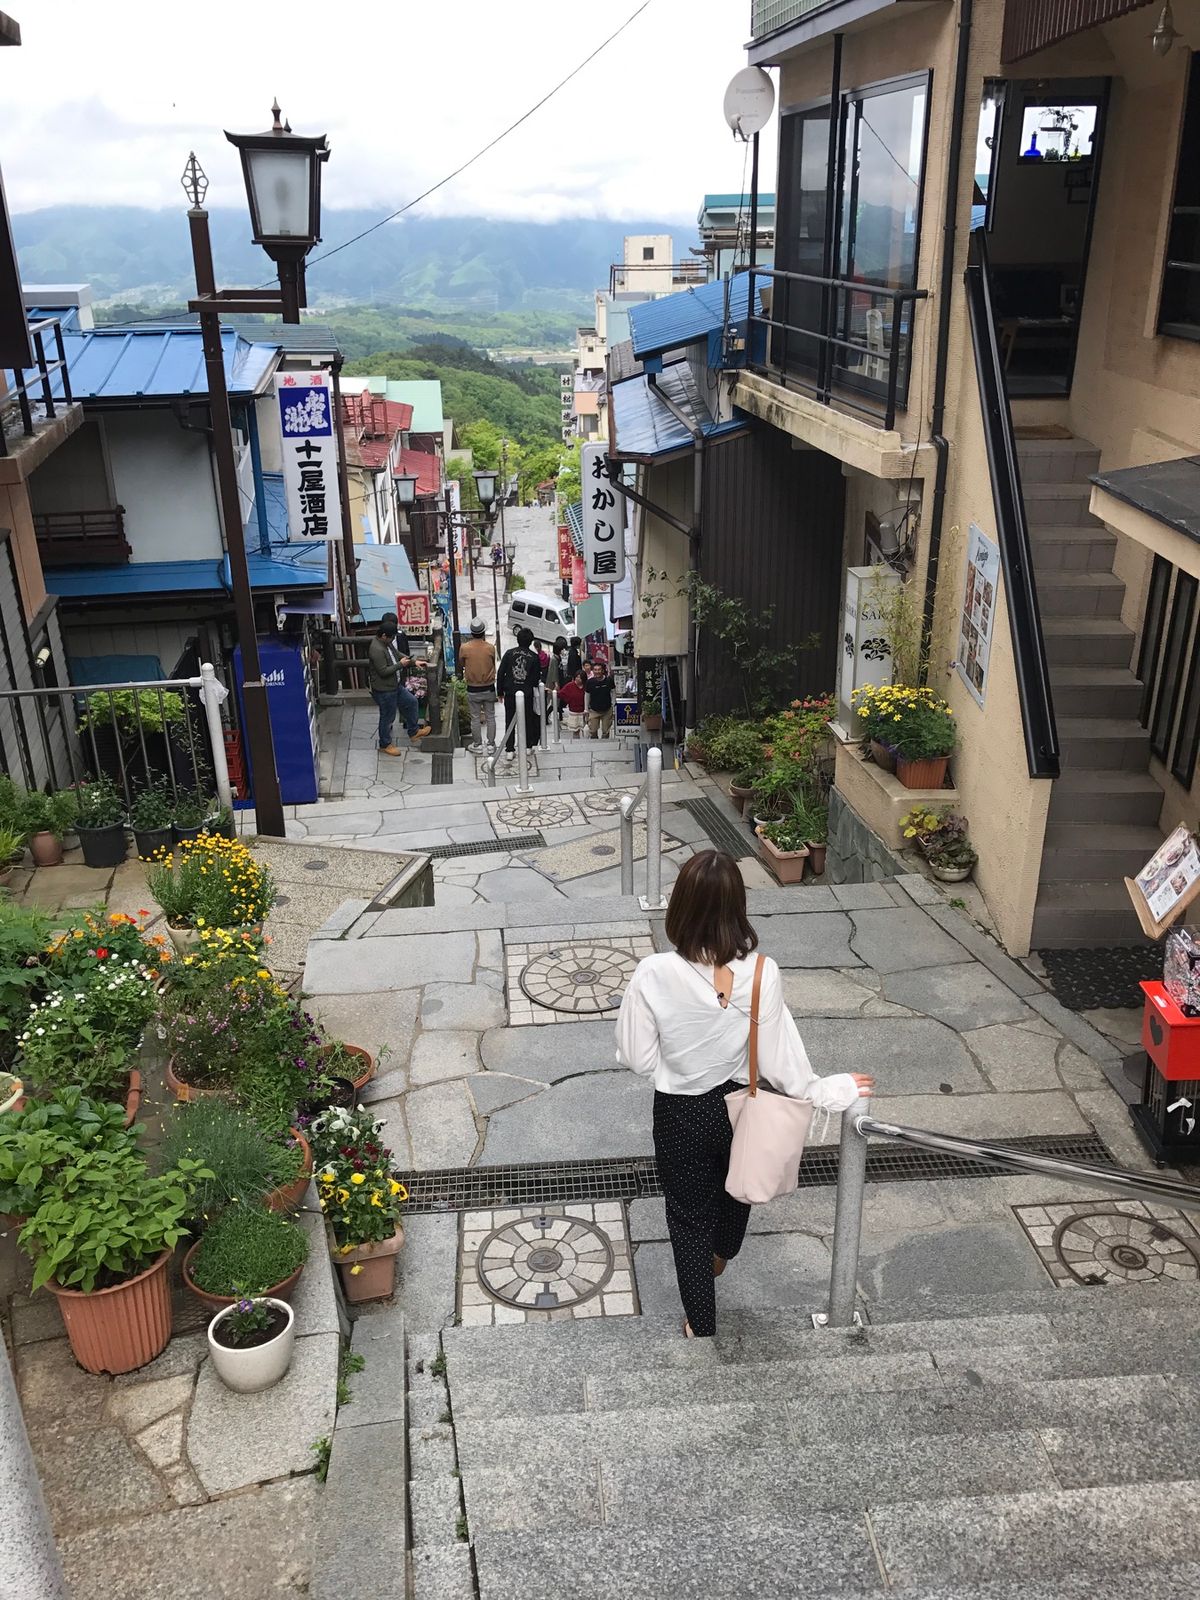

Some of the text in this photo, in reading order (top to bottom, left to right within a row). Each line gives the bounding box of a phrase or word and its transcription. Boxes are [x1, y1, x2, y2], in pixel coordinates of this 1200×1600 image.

[284, 375, 323, 386] 地酒
[295, 439, 328, 537] 十一屋酒店
[592, 456, 616, 574] おかし屋
[400, 597, 426, 623] 酒
